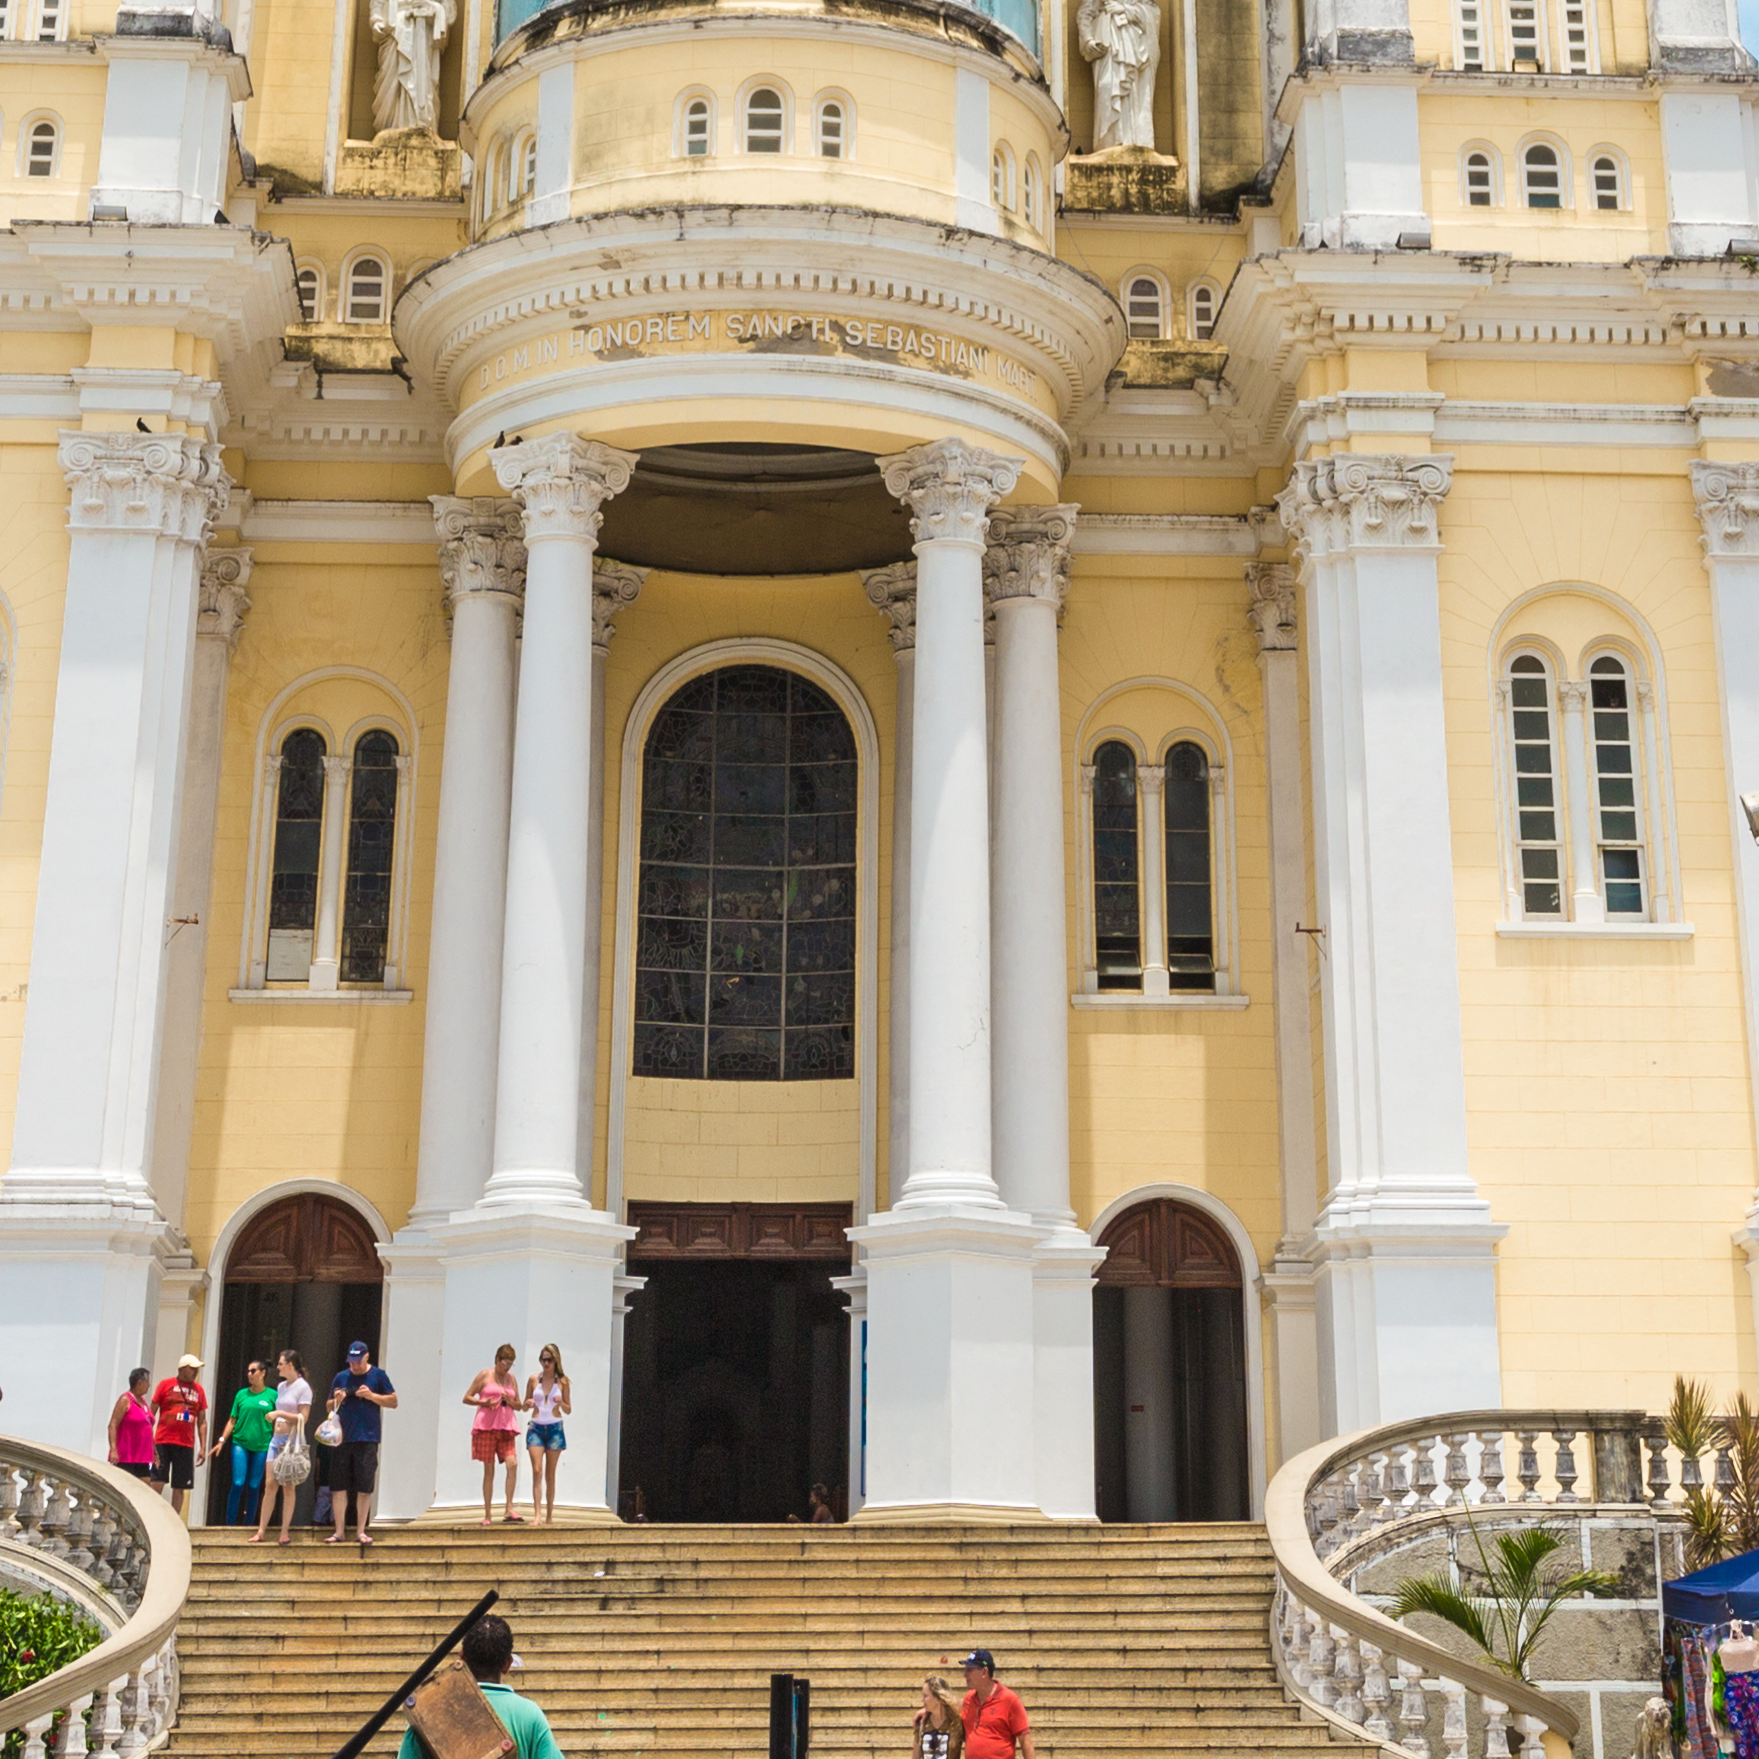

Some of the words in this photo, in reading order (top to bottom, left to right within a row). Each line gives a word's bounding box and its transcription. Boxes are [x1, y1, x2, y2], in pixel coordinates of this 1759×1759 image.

[537, 336, 558, 365] IN
[569, 314, 711, 357] HONOREM
[726, 313, 831, 343] SANCTI
[844, 320, 989, 375] SEBASTIANI
